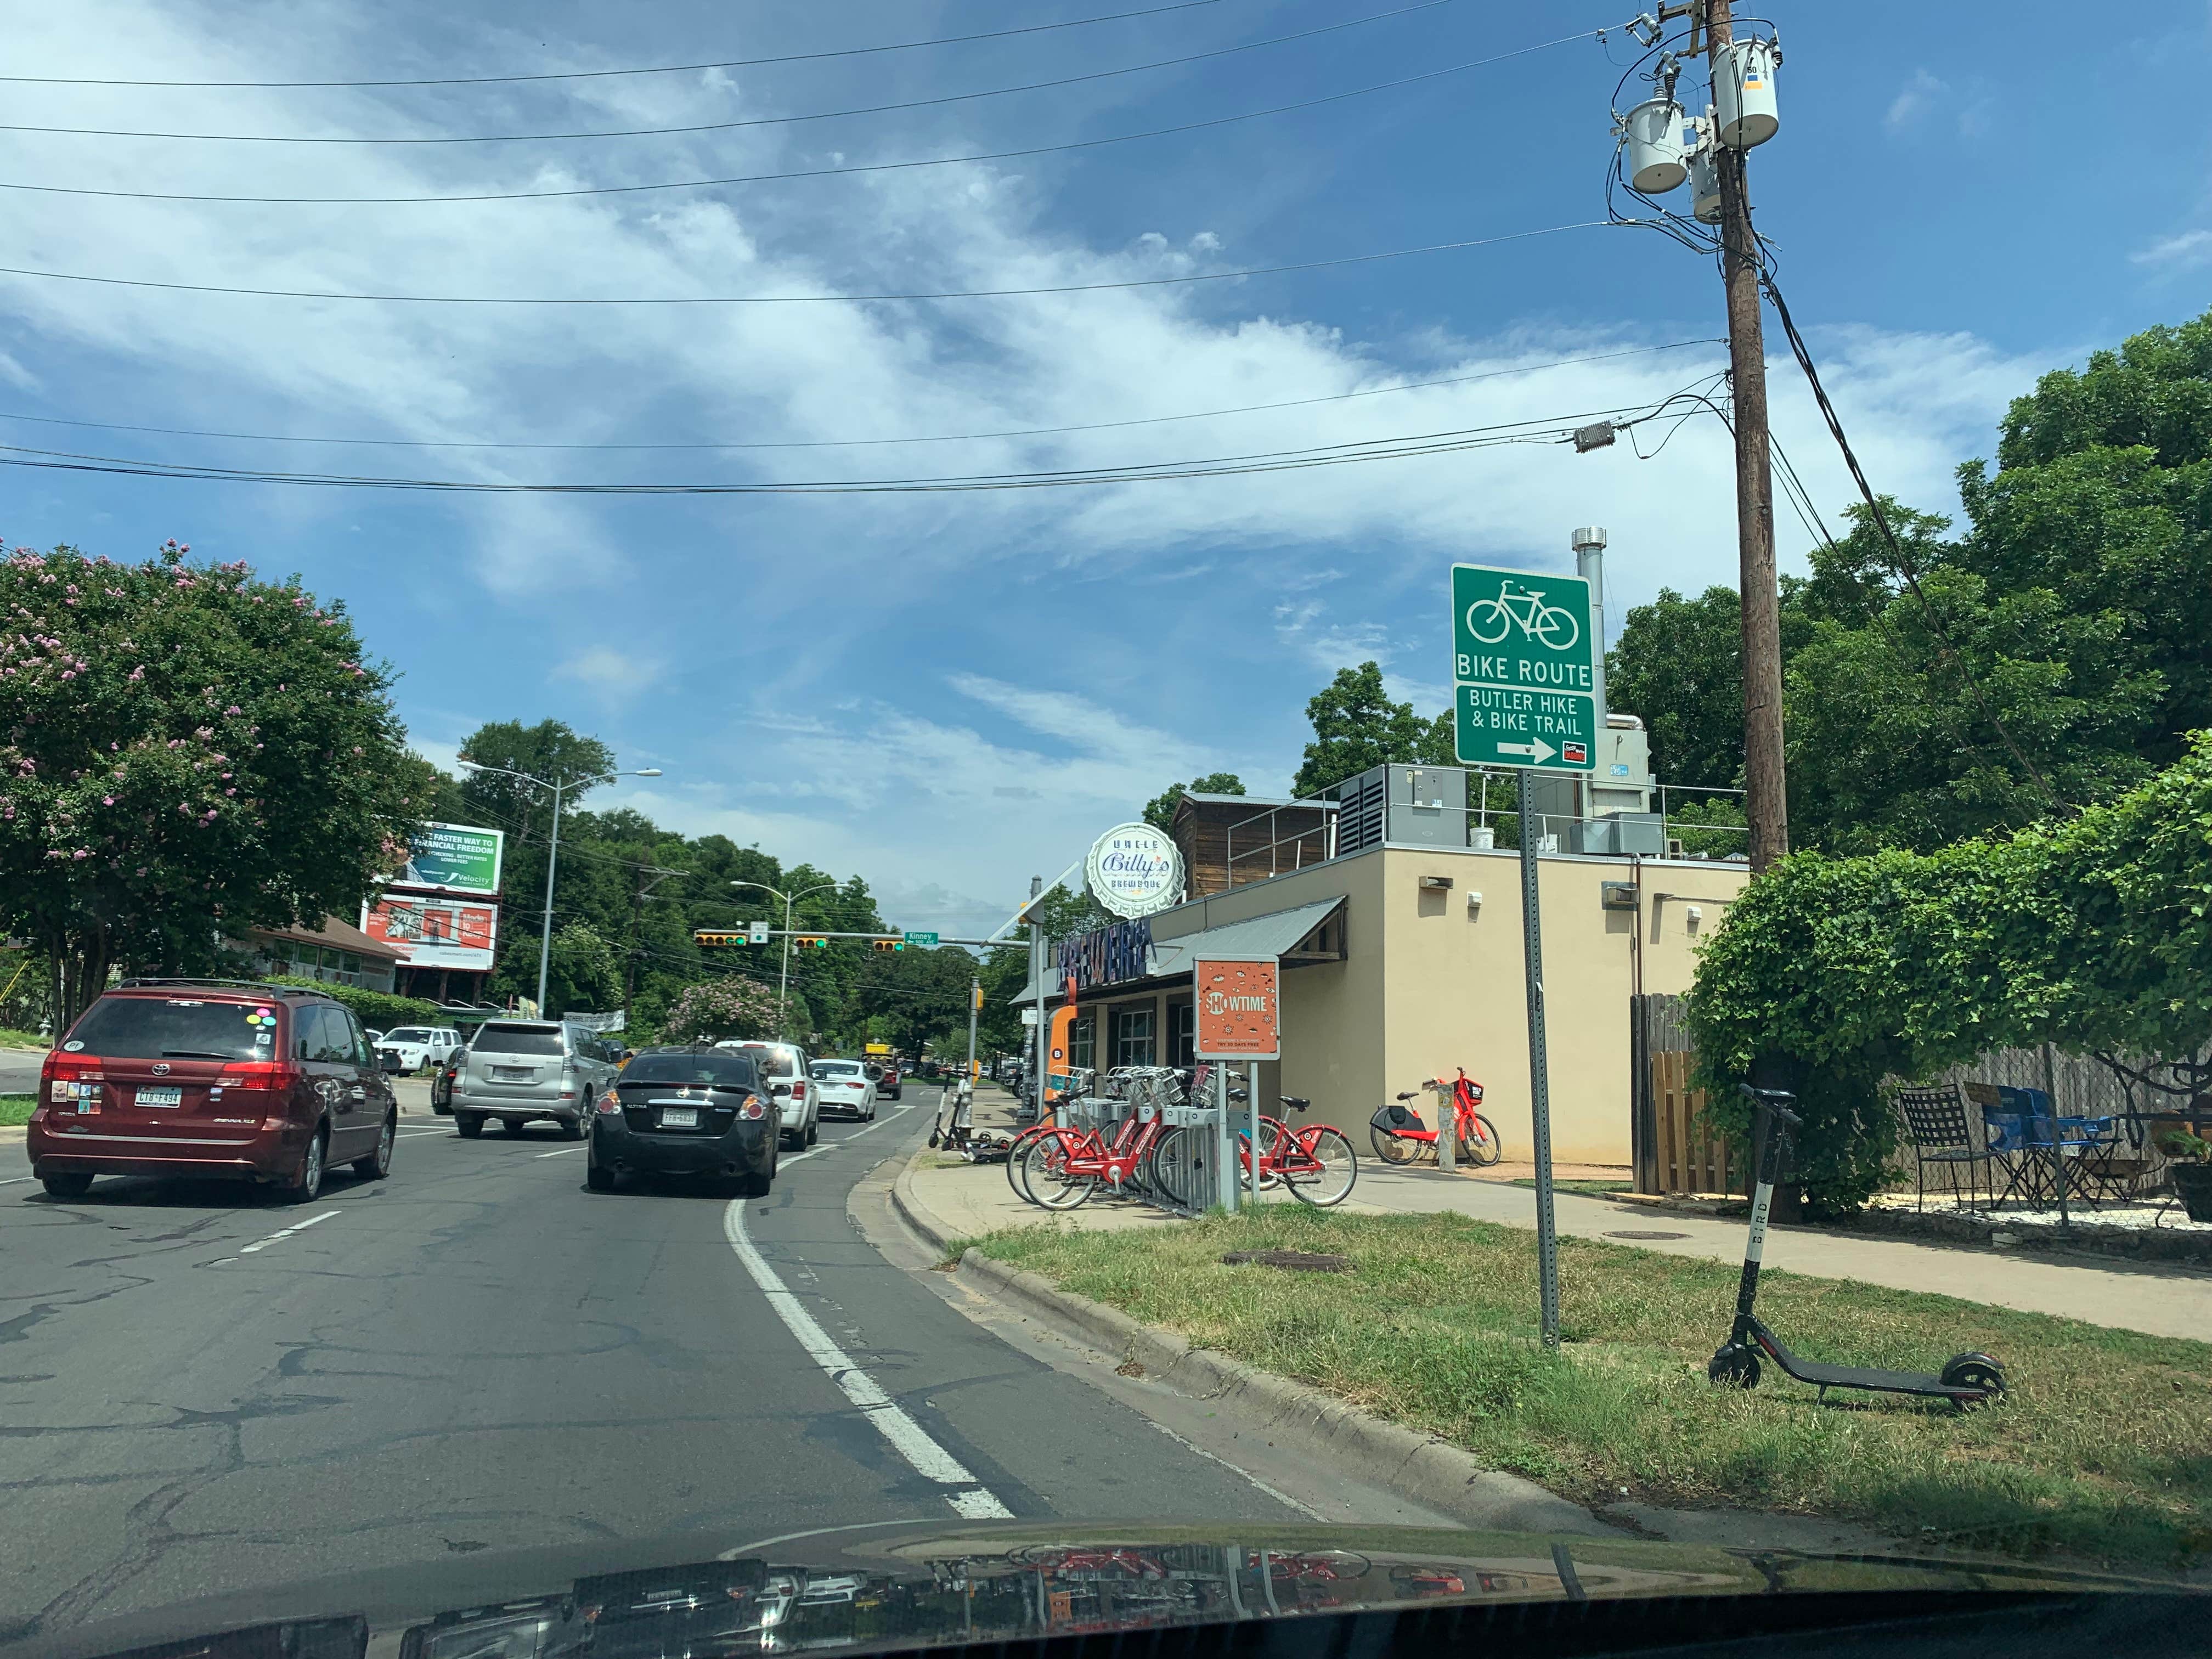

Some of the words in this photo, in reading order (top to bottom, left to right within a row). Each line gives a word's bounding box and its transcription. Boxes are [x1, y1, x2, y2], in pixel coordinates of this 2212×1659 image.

[1457, 653, 1509, 679] BIKE
[1519, 659, 1591, 686] ROUTE
[1470, 689, 1533, 711] BUTLER
[1541, 695, 1577, 714] HIKE
[1472, 710, 1484, 727] &
[1491, 712, 1528, 731] BIKE
[1534, 715, 1582, 735] TRAIL
[434, 833, 462, 843] FASTER
[464, 837, 481, 845] WAY
[457, 844, 494, 854] FREEDOM
[1114, 840, 1158, 849] UNCLE
[1102, 853, 1169, 878] Billy's
[458, 873, 489, 885] Velocity
[1206, 992, 1267, 1015] SHOWTIME
[1752, 1203, 1768, 1244] BIRD
